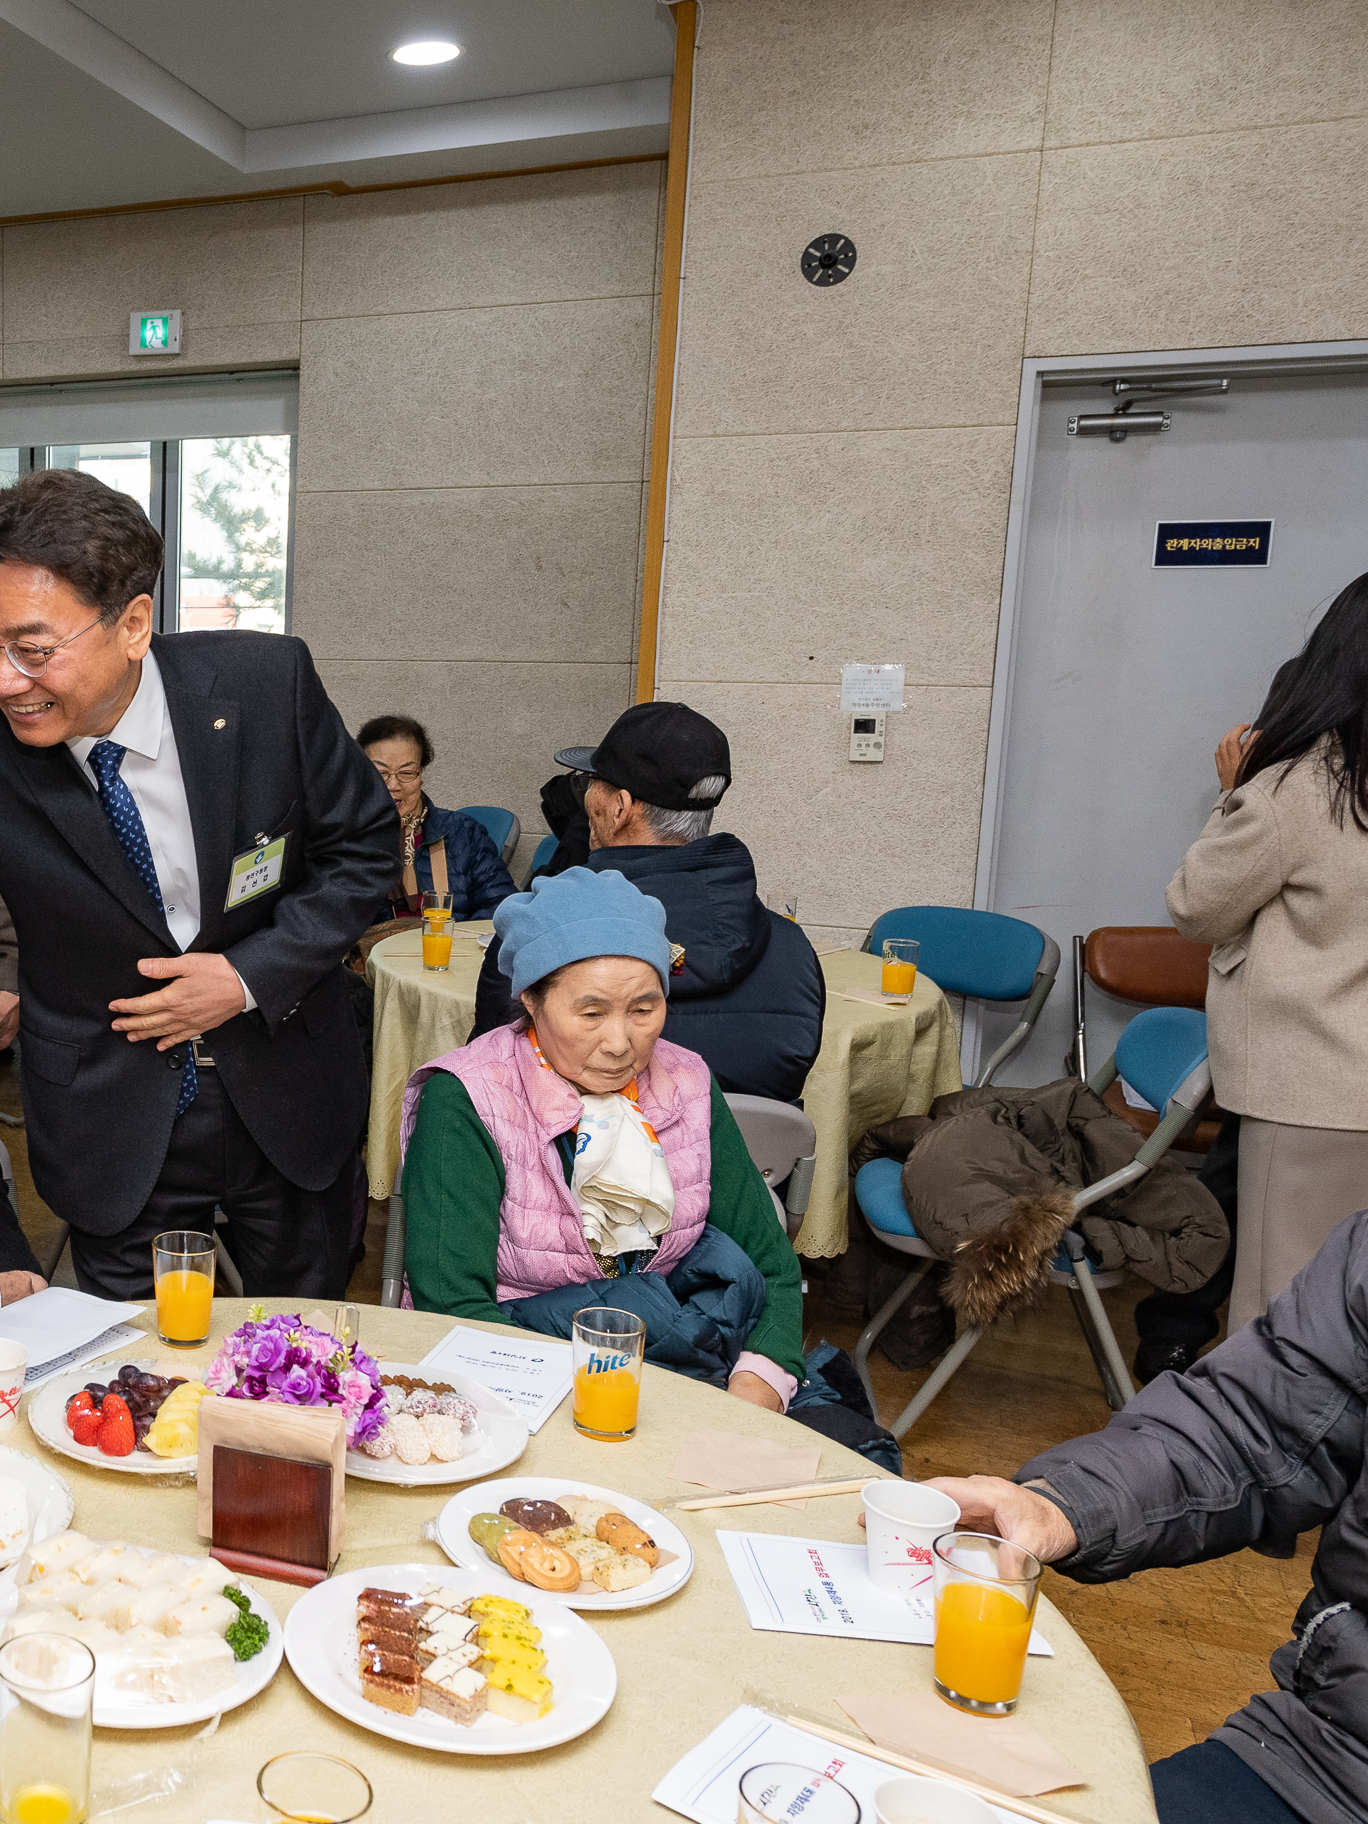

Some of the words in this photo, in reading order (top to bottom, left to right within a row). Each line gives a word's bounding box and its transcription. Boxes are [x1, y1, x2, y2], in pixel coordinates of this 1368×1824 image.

[1165, 537, 1260, 551] 관계자외출입금지
[587, 1352, 632, 1375] hite
[807, 1549, 830, 1578] 업무보고회
